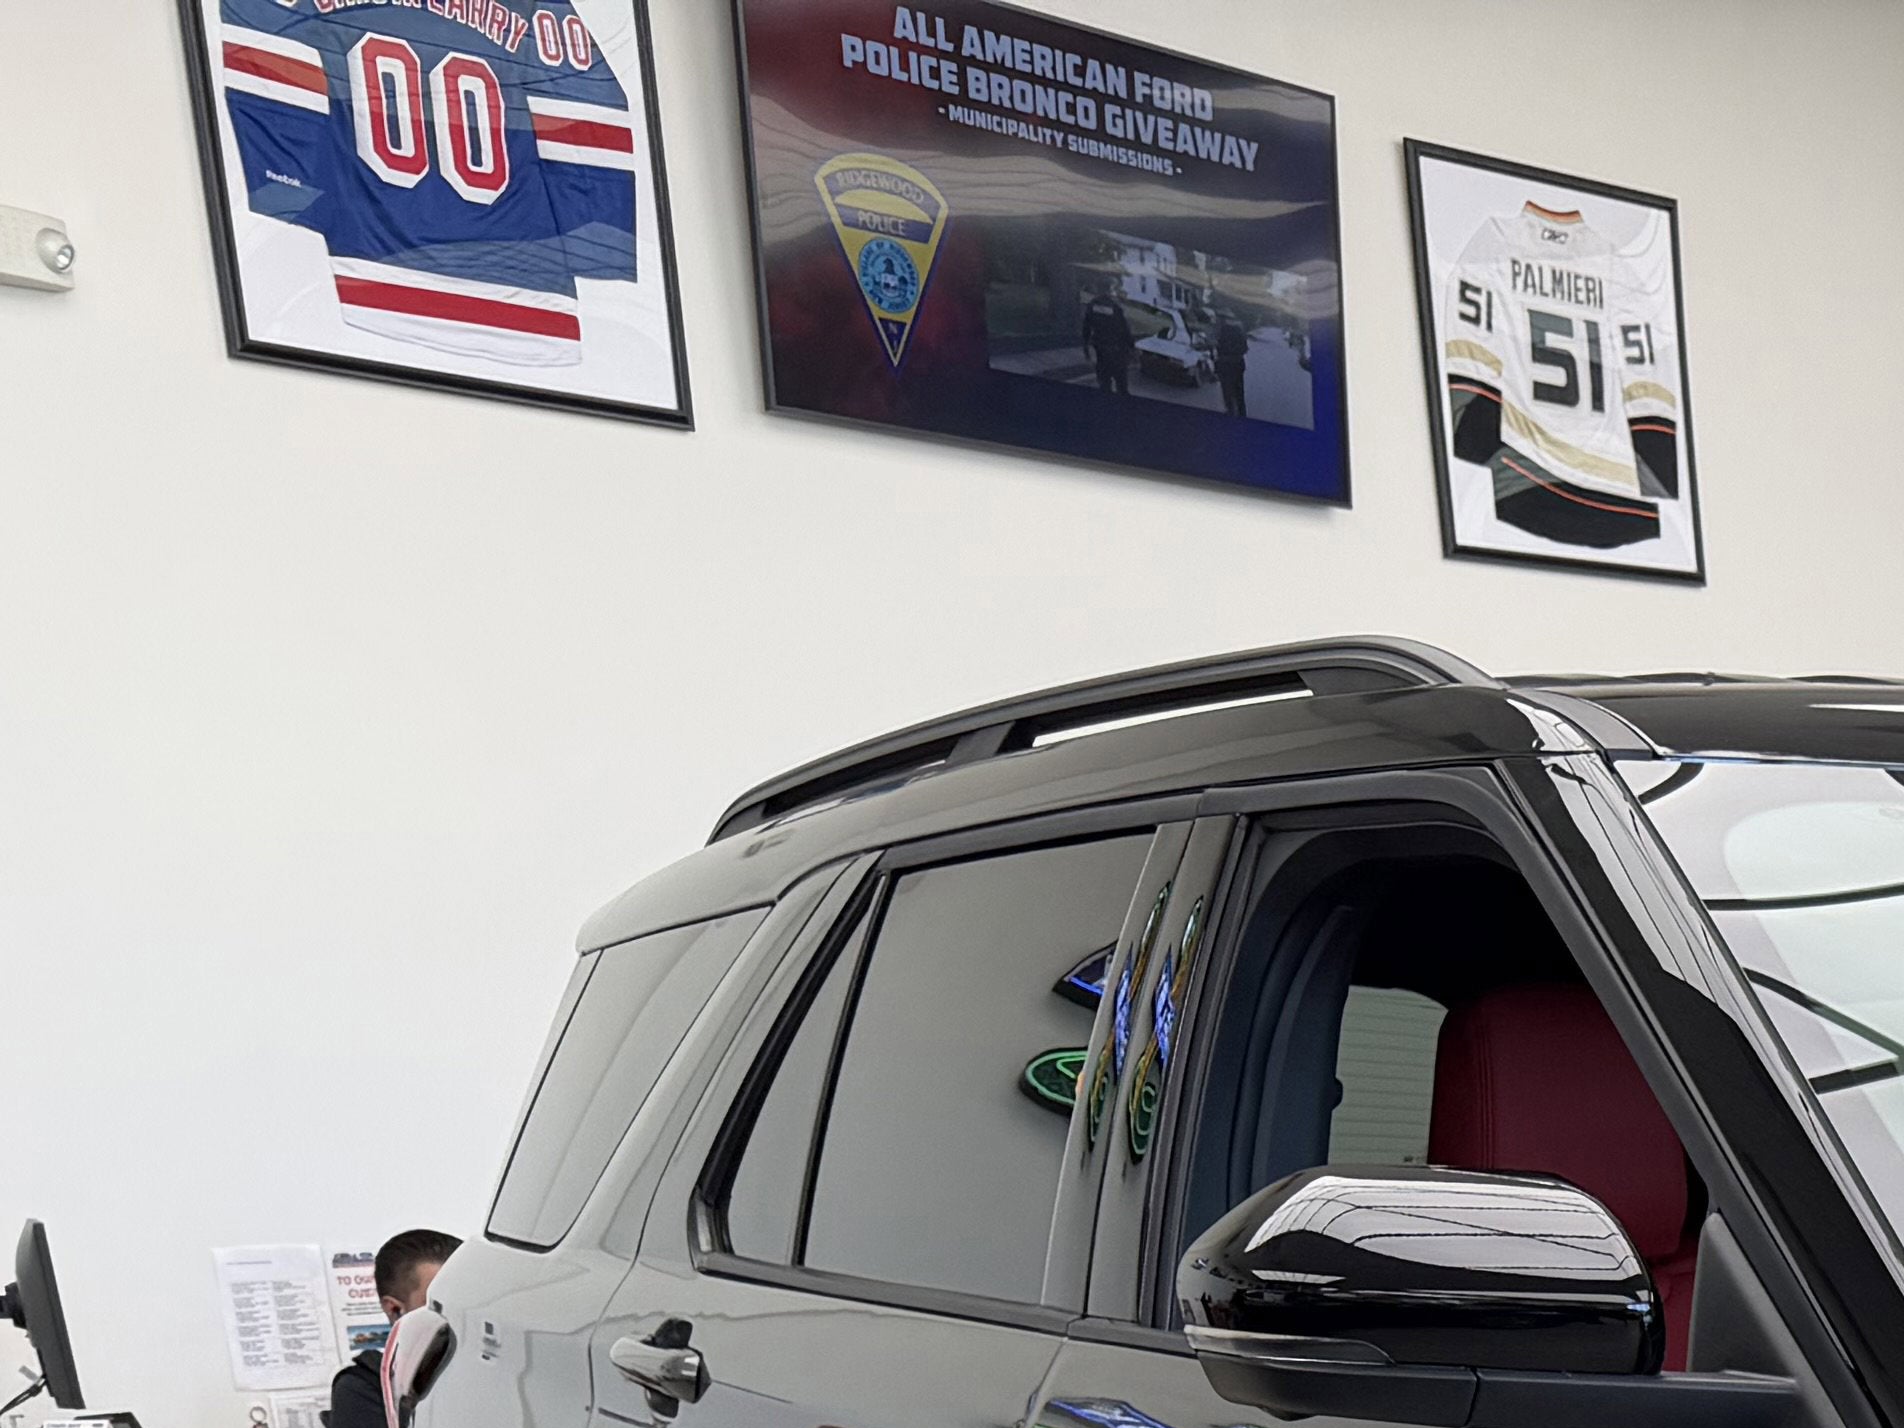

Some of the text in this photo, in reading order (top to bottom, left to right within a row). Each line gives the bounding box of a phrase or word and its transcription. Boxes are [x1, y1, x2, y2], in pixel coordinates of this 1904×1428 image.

[533, 10, 592, 71] 00
[893, 6, 1214, 123] ALL AMERICAN FORD
[346, 31, 511, 206] 00
[841, 33, 1260, 172] POLICE BRONCO GIVEAWAY
[947, 105, 1174, 178] MUNICIPALITY SUBMISSIONS
[835, 170, 925, 206] RIDGEWOOD
[857, 210, 906, 237] POLICE
[1458, 280, 1494, 333] 51
[1510, 257, 1605, 310] PALMIERI
[1527, 308, 1606, 414] 51
[1620, 322, 1655, 366] 51
